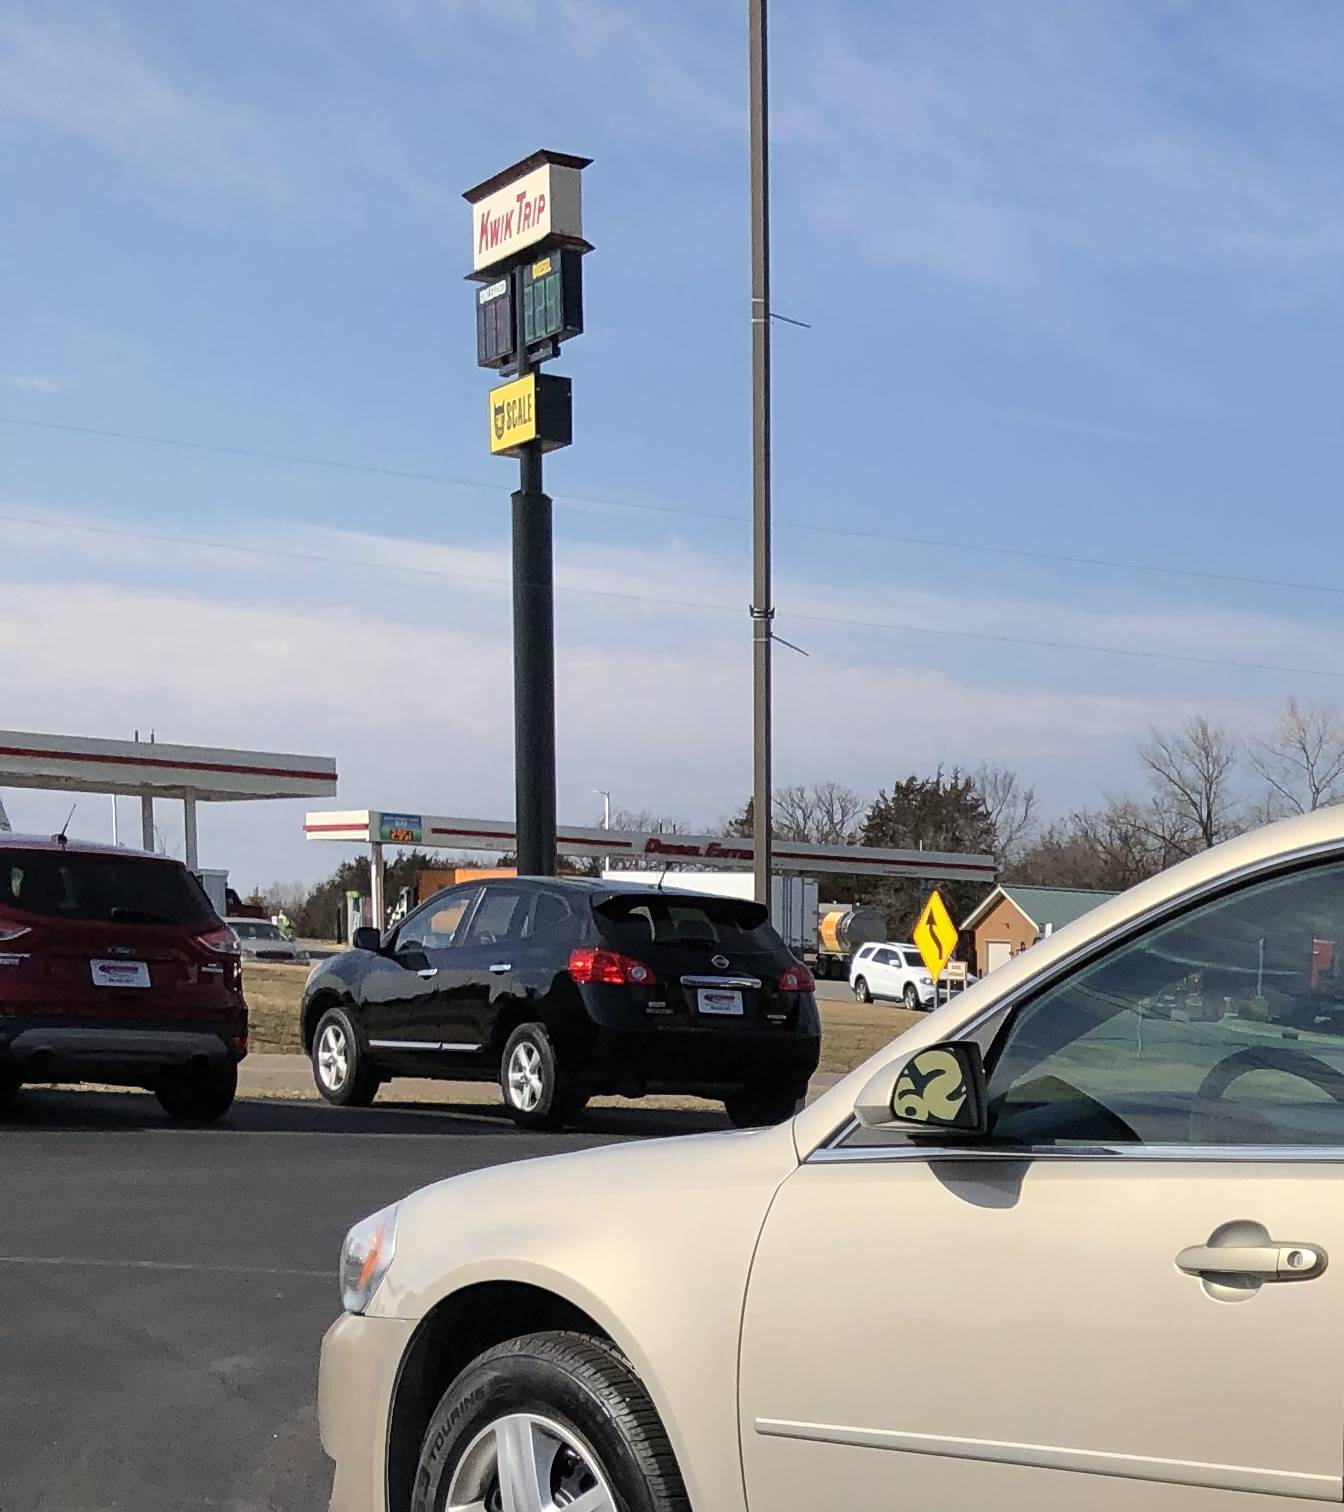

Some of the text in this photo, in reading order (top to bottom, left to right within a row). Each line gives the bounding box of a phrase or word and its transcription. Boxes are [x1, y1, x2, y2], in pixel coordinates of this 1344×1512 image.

[478, 190, 546, 255] KWIK TRIP
[506, 393, 532, 431] SCALE
[428, 1384, 486, 1462] TOURING
